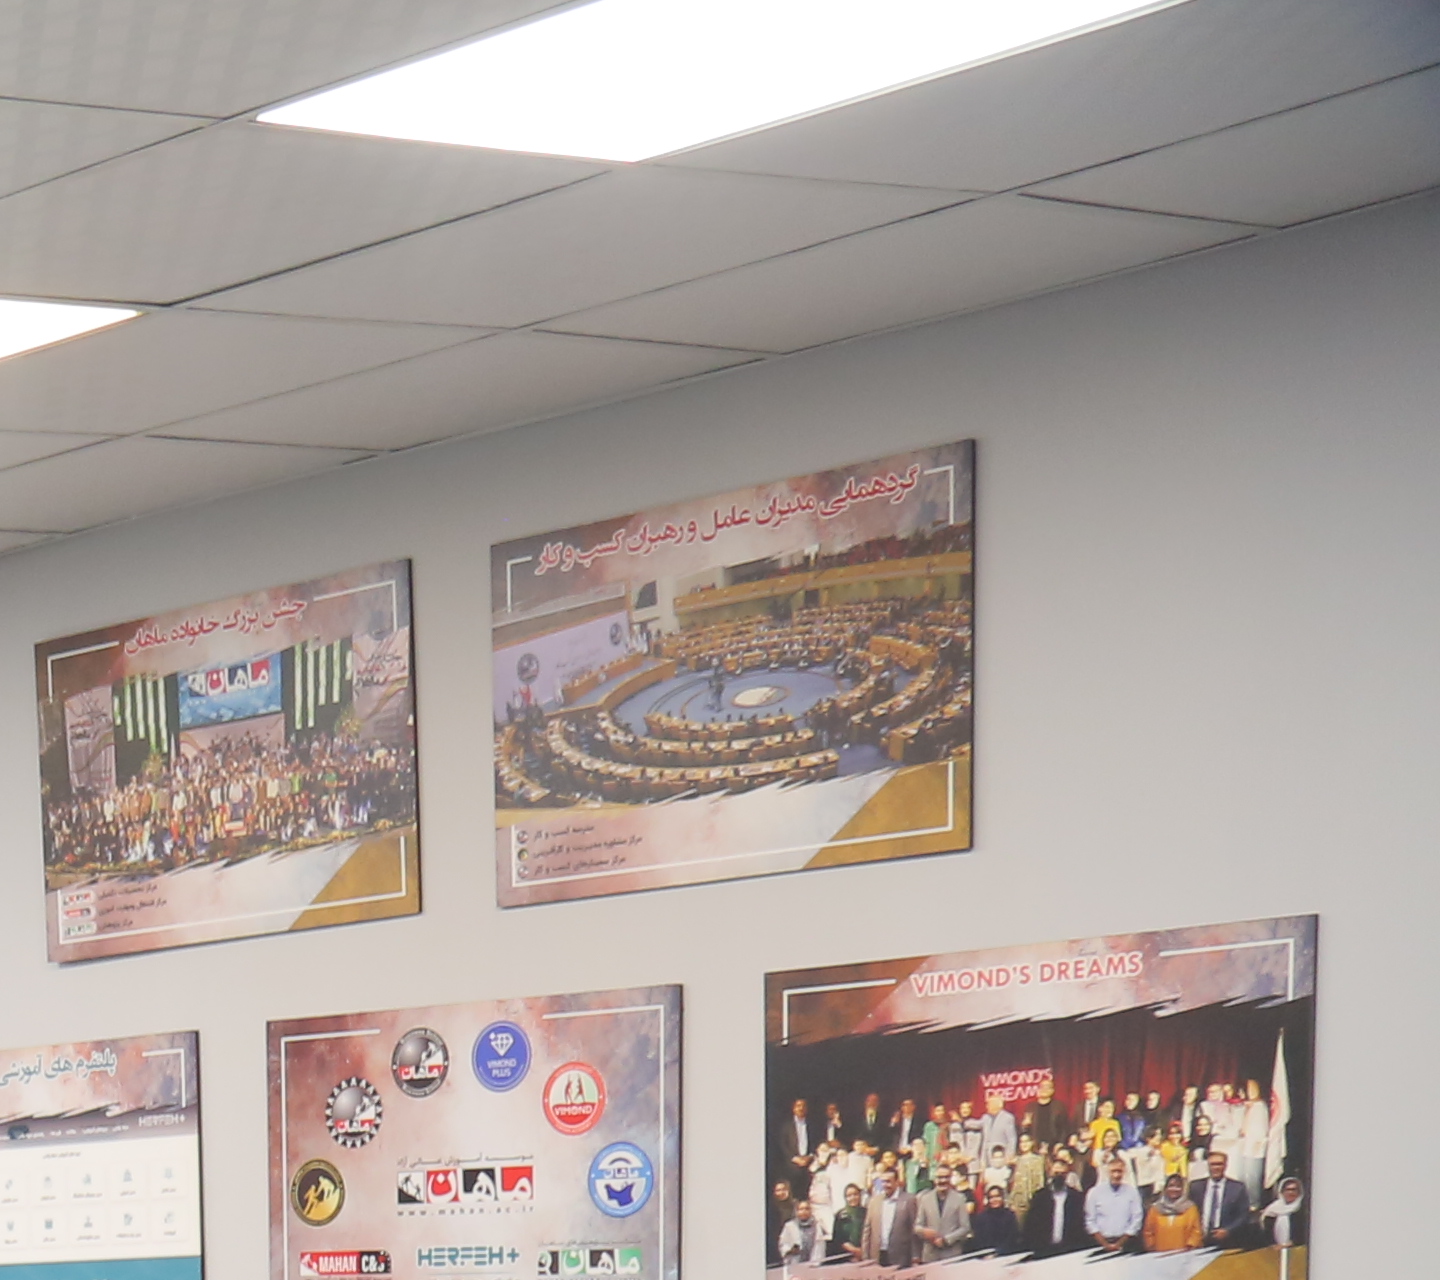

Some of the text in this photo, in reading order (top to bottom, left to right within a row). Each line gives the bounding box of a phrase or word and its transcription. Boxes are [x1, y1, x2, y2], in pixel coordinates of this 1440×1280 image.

[534, 465, 920, 576] گردهمایی مدیران عامل و رهبران کسب و کار
[124, 600, 307, 655] جشن بزرگ خانواده ماهان
[206, 659, 271, 697] ماهان
[912, 953, 1143, 996] VIMOND'S DREAMS
[44, 1056, 73, 1079] های
[75, 1049, 117, 1078] پلتفرم
[980, 1068, 1053, 1088] VIMOND'S
[554, 1105, 593, 1116] VIMOND
[427, 1165, 533, 1203] ماهان
[318, 1256, 357, 1273] MAHAN
[562, 1248, 641, 1275] ماهان
